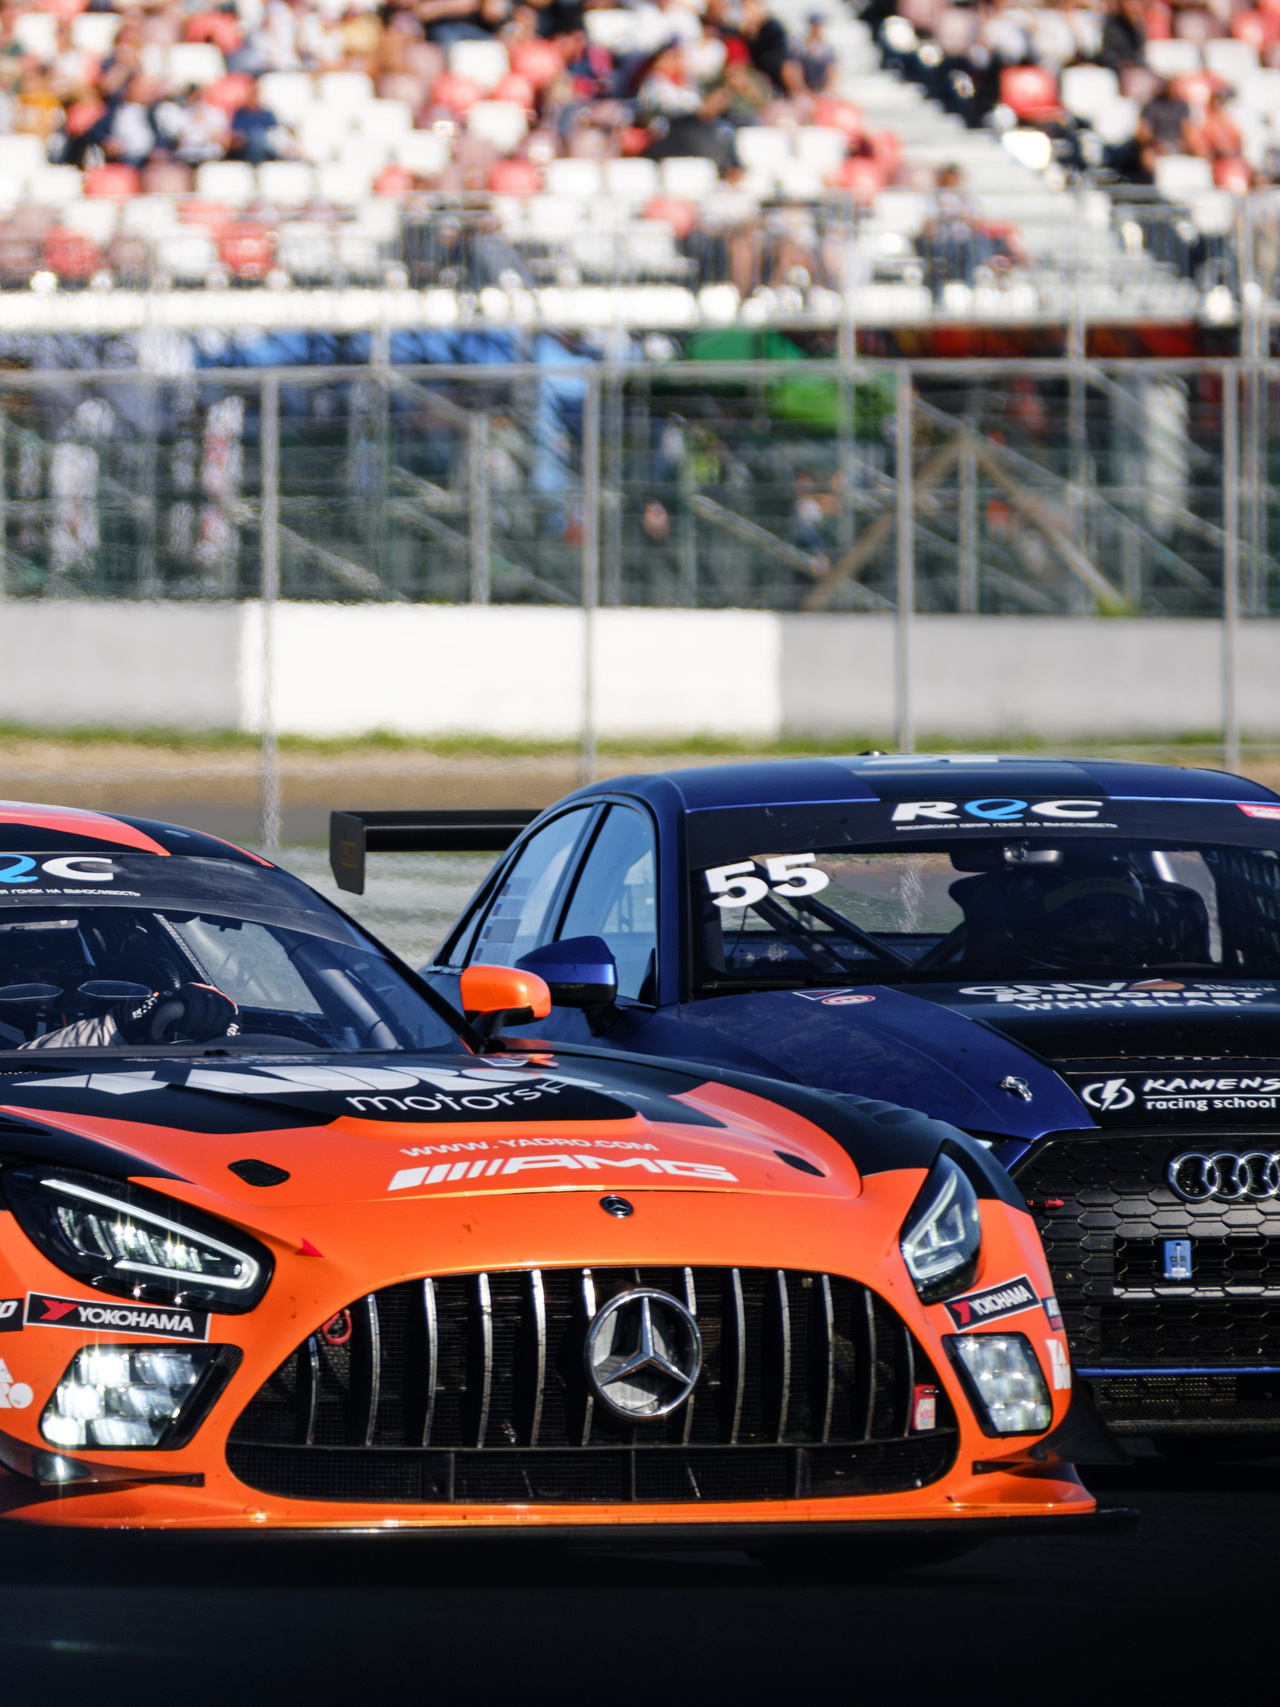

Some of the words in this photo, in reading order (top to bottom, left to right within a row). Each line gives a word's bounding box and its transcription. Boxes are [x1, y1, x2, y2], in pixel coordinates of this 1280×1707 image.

[705, 852, 830, 908] 55
[1146, 1099, 1209, 1112] racing
[1213, 1097, 1276, 1109] school
[969, 1285, 1034, 1316] YOKOHAMA
[77, 1306, 194, 1333] YOKOHAMA
